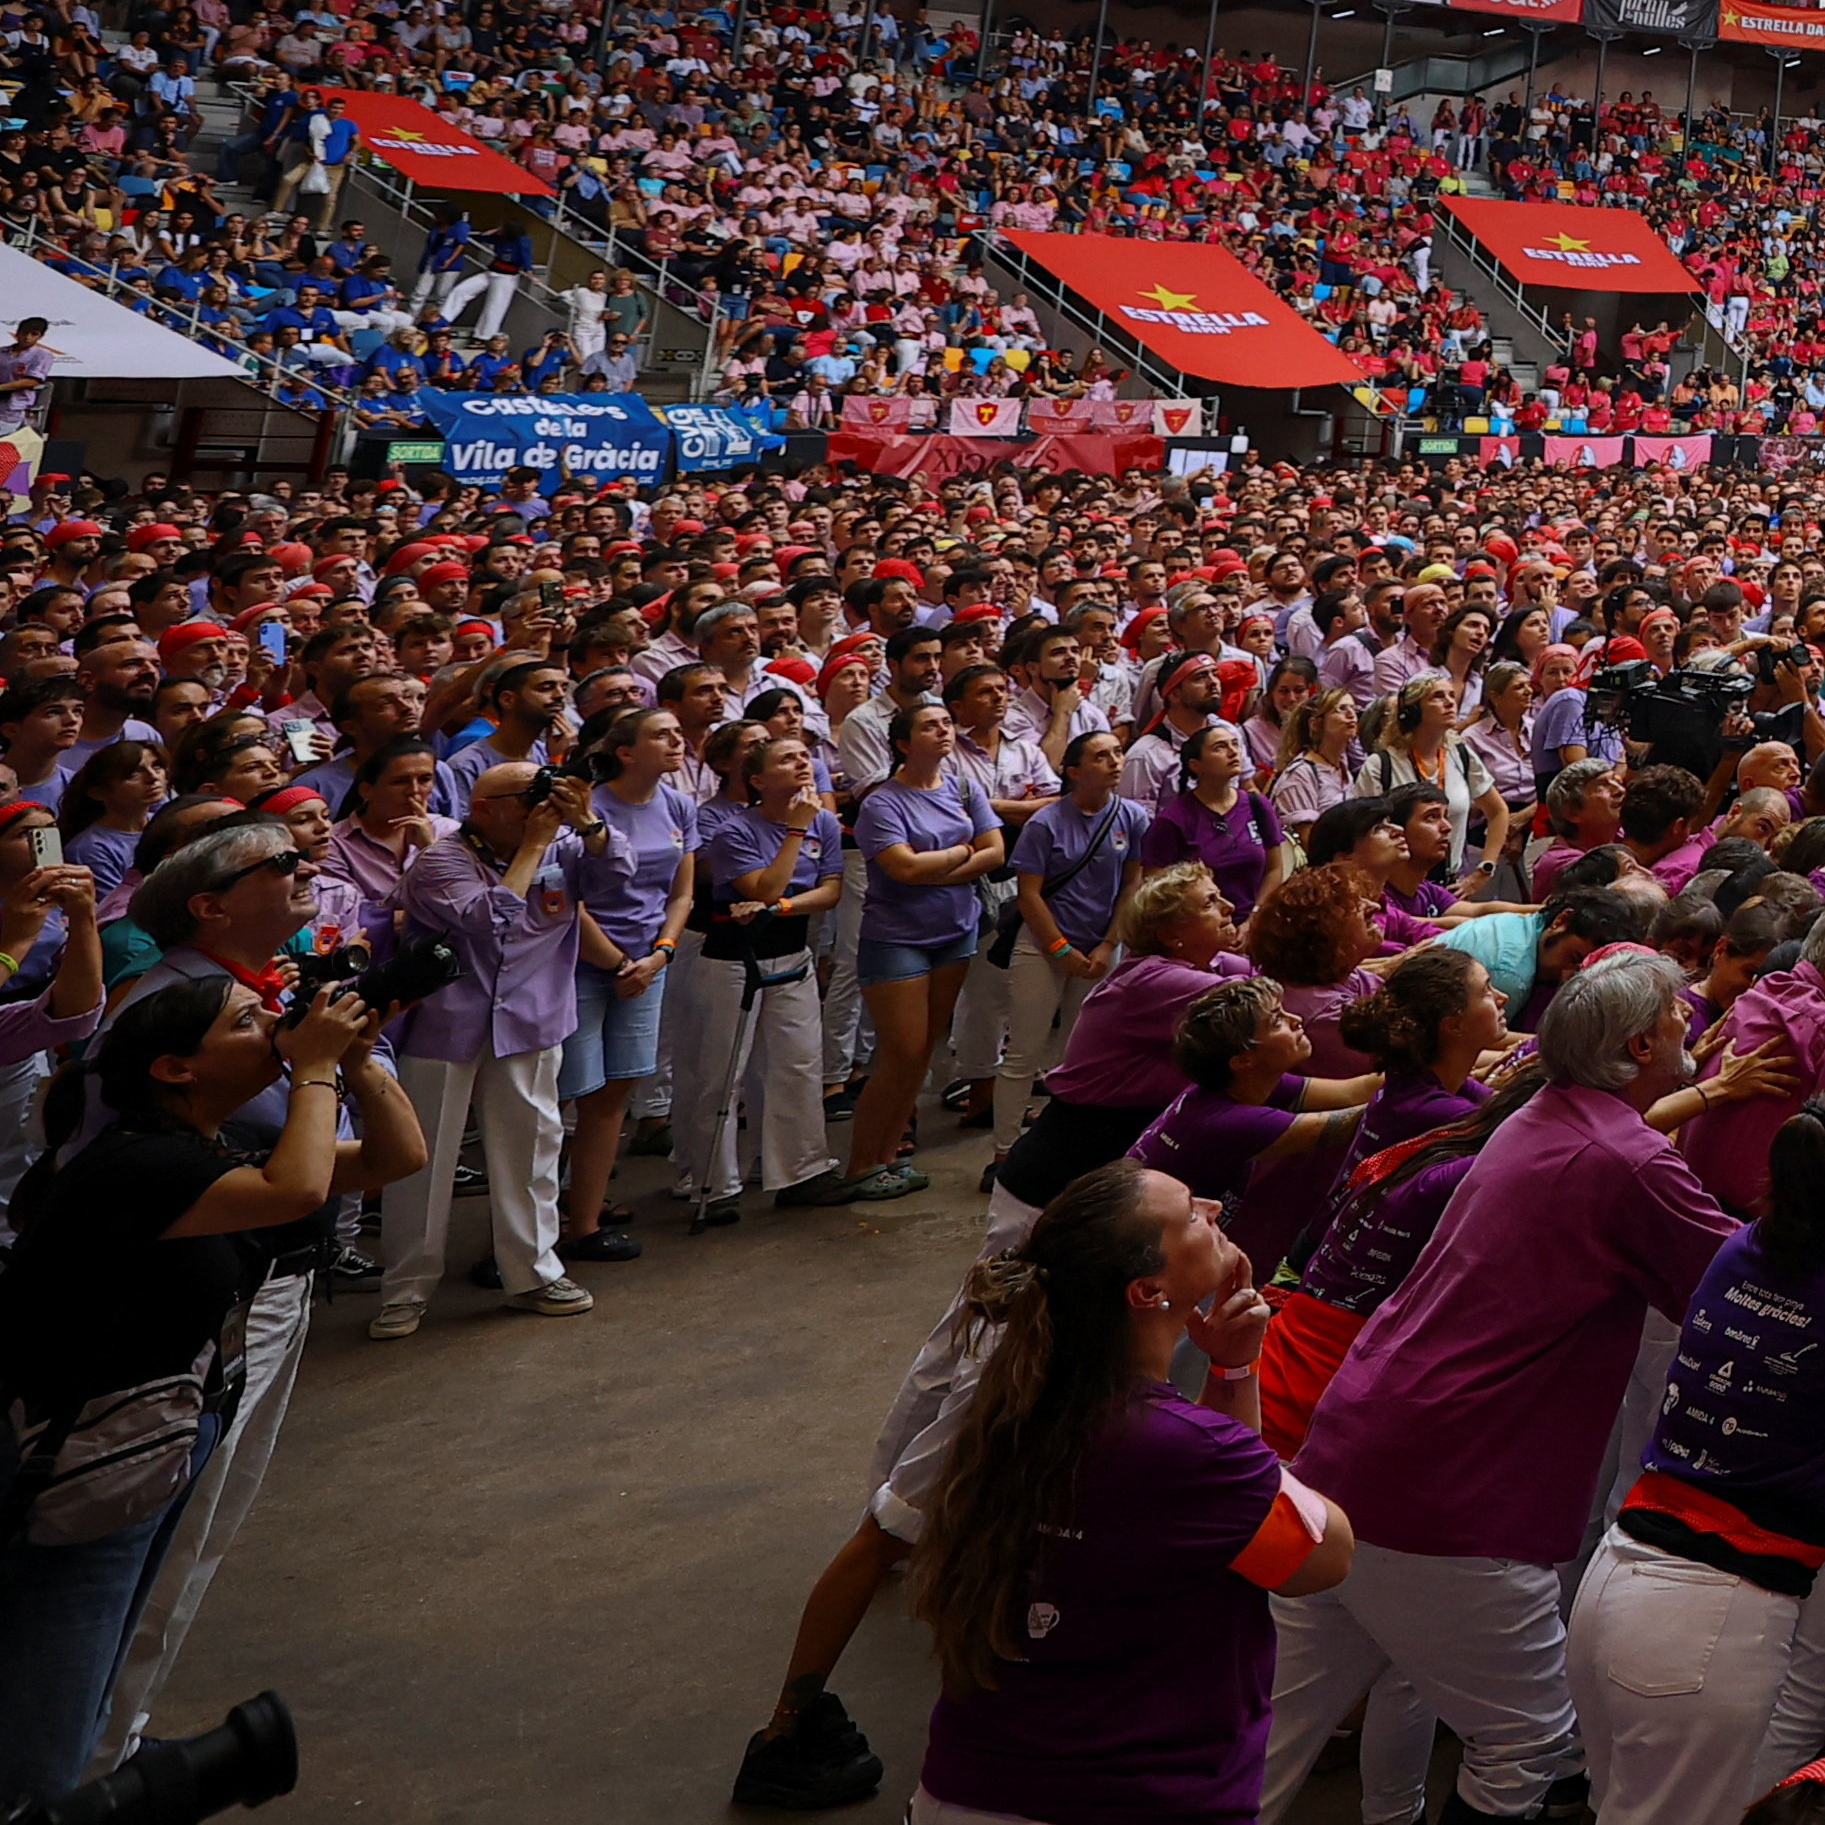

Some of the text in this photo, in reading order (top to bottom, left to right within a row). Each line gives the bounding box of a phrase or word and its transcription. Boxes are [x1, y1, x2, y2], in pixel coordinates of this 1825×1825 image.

[1741, 15, 1804, 36] ESTRELLA
[369, 135, 481, 156] ESTRELLA
[1523, 247, 1641, 266] ESTRELLA
[1119, 304, 1270, 329] ESTRELLA
[671, 407, 704, 458] CVG
[451, 440, 660, 471] Vila de Gràcia
[1723, 1286, 1812, 1329] Moltes gràcies!
